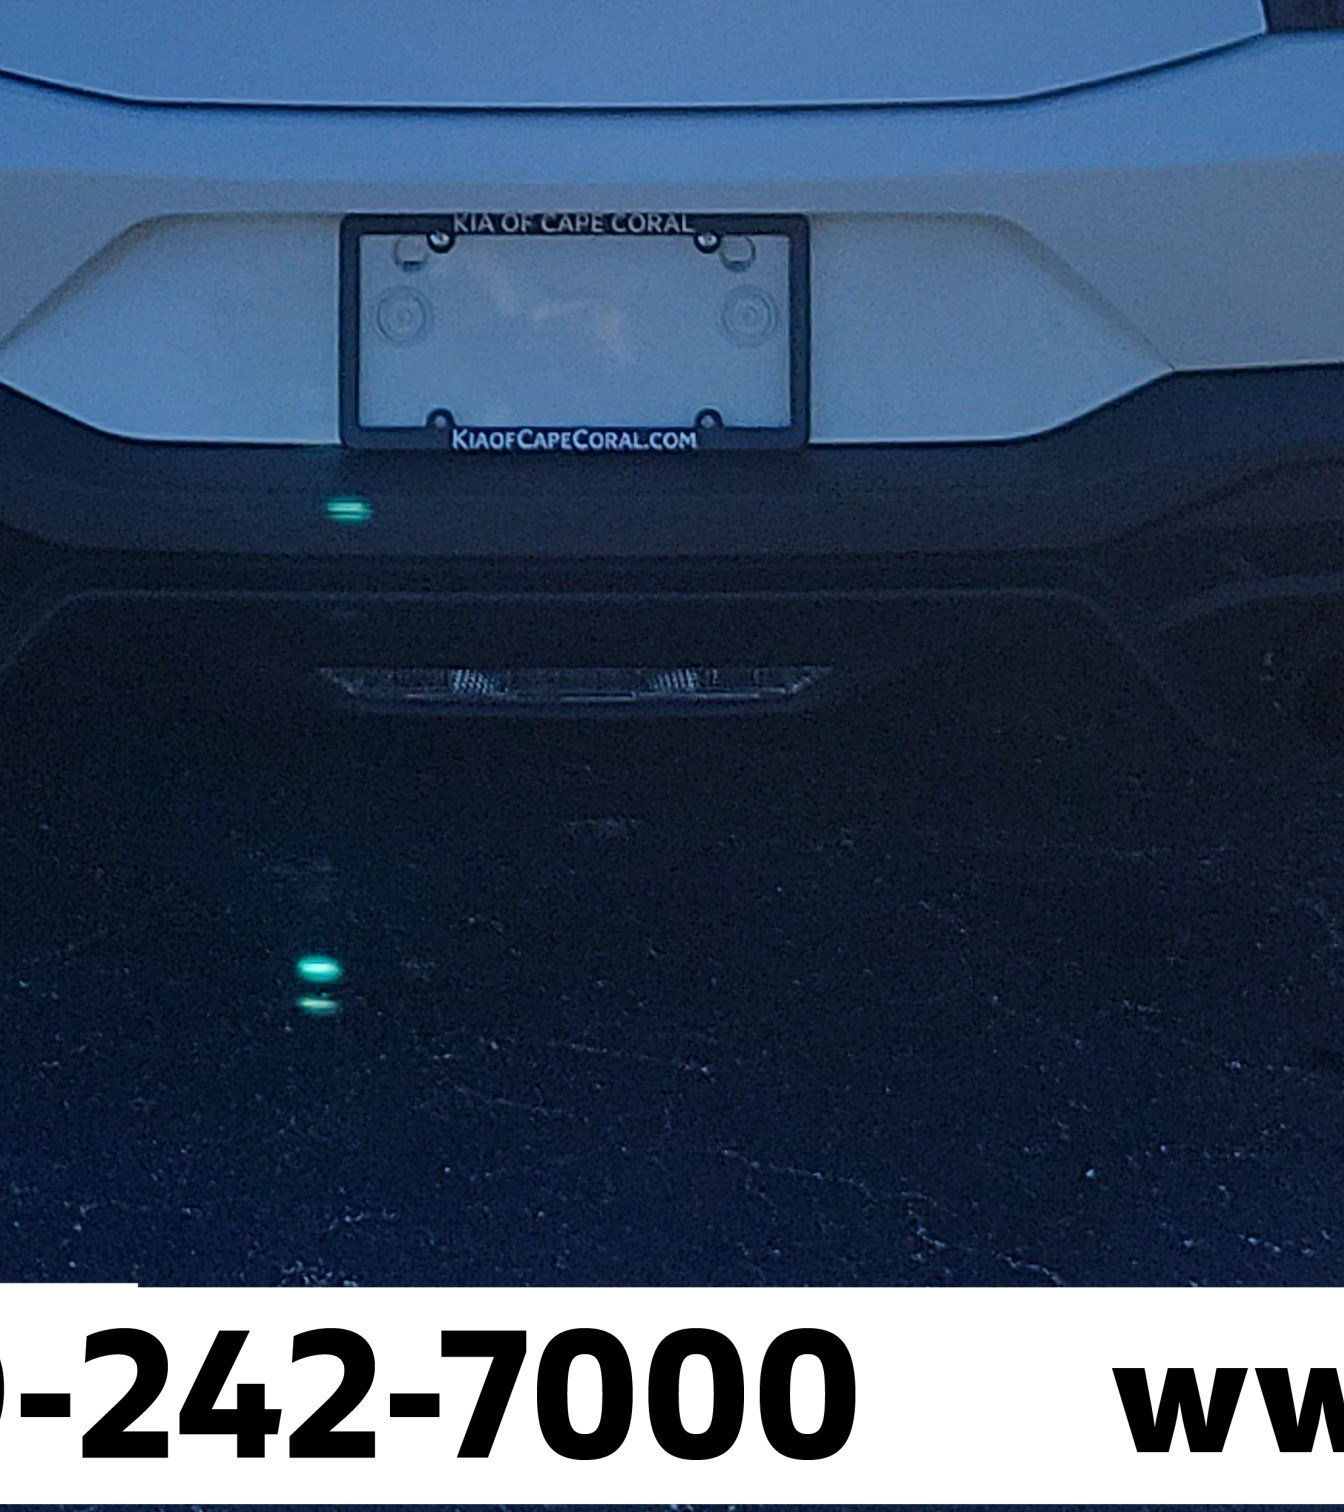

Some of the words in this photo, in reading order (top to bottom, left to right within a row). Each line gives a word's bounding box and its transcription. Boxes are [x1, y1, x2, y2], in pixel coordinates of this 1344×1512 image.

[453, 212, 496, 233] KIA
[501, 212, 533, 233] OF
[540, 212, 605, 233] CAPE
[611, 212, 696, 234] CORAL
